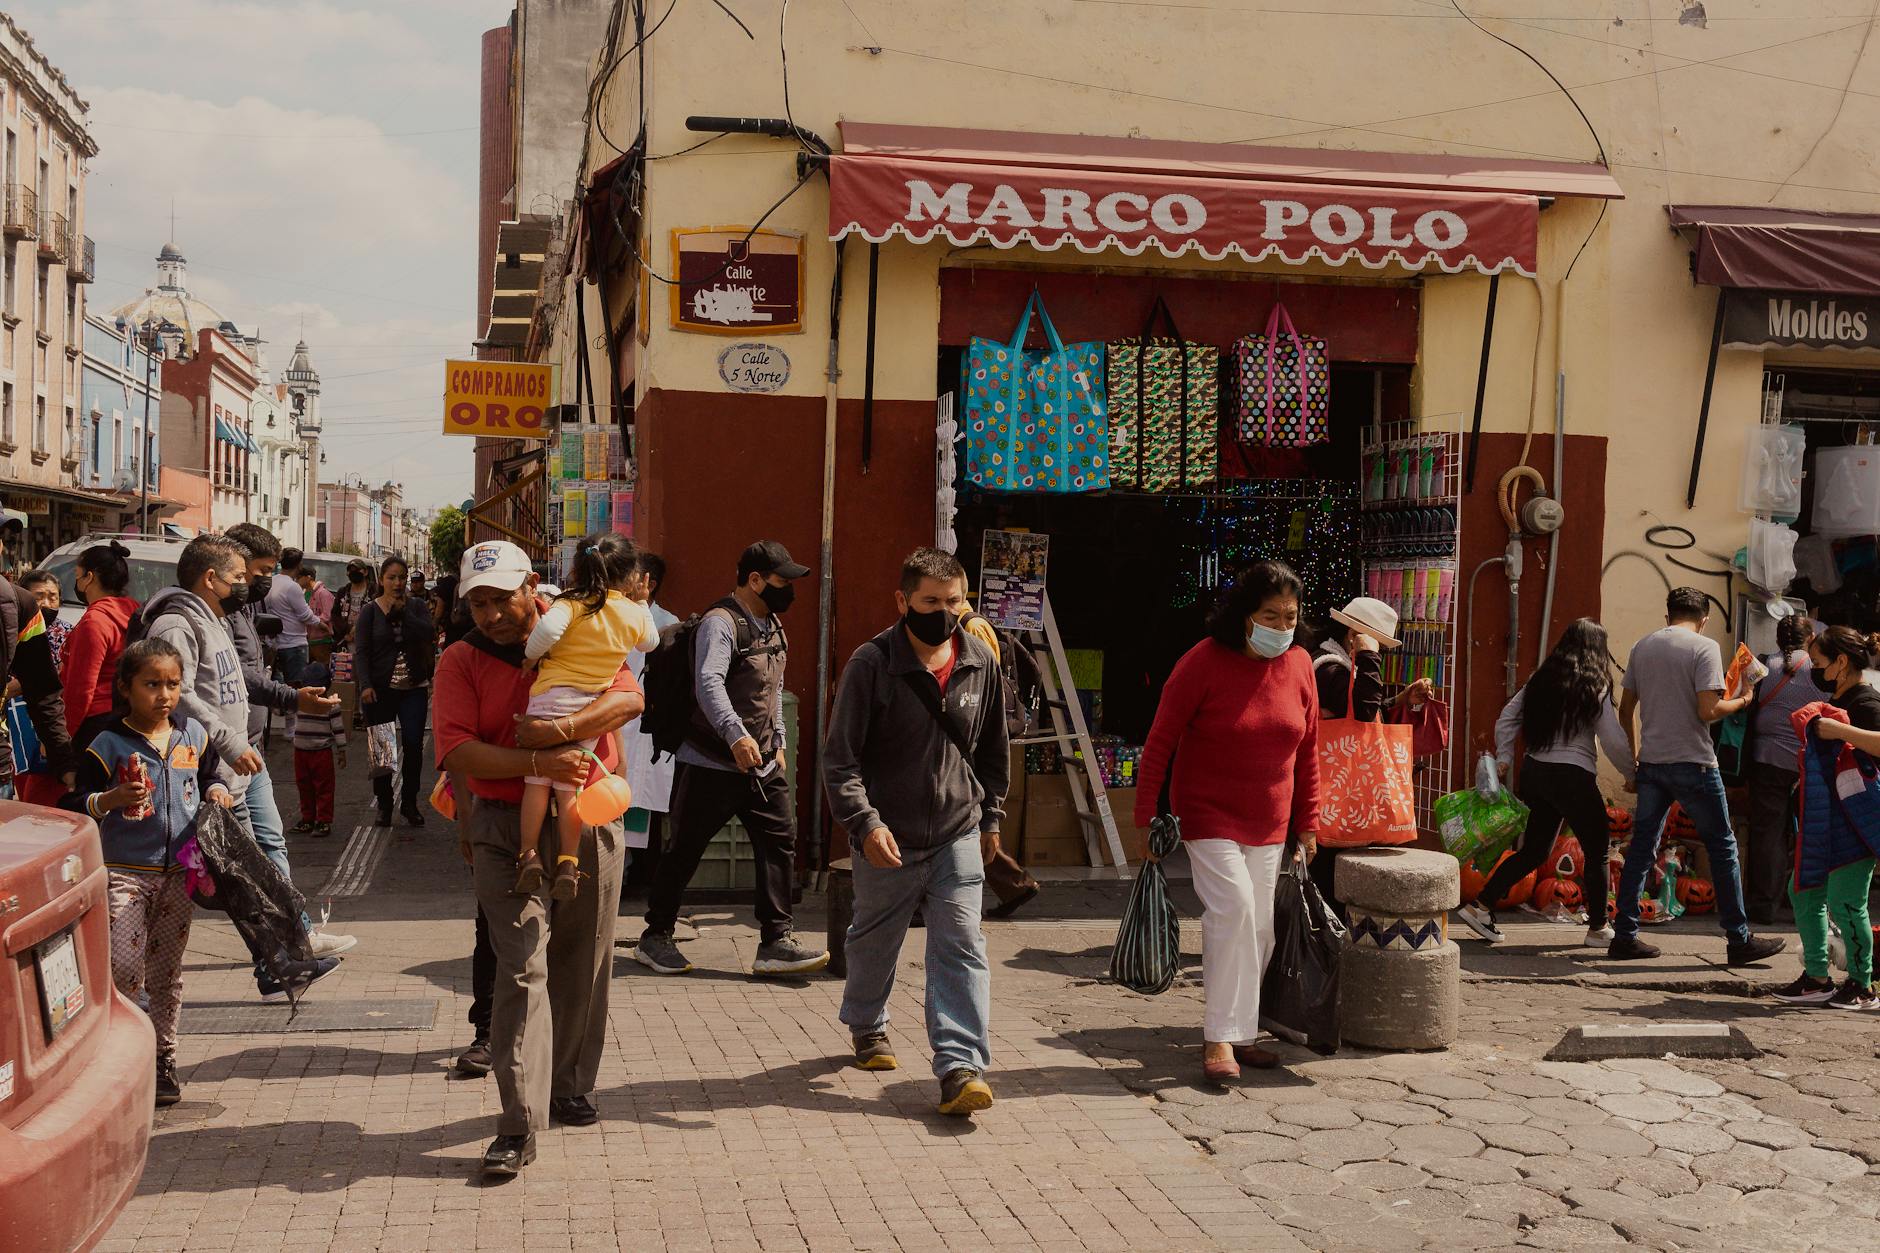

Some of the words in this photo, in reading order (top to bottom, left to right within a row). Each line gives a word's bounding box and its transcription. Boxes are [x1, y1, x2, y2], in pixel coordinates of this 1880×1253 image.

[904, 180, 1207, 234] MARCO
[1260, 200, 1468, 249] POLO
[726, 265, 753, 280] Calle
[1768, 298, 1868, 341] Moldes
[741, 351, 770, 365] Calle
[452, 369, 546, 398] COMPRAMOS
[730, 367, 741, 382] 5
[744, 367, 782, 385] Norte
[450, 402, 544, 429] ORO
